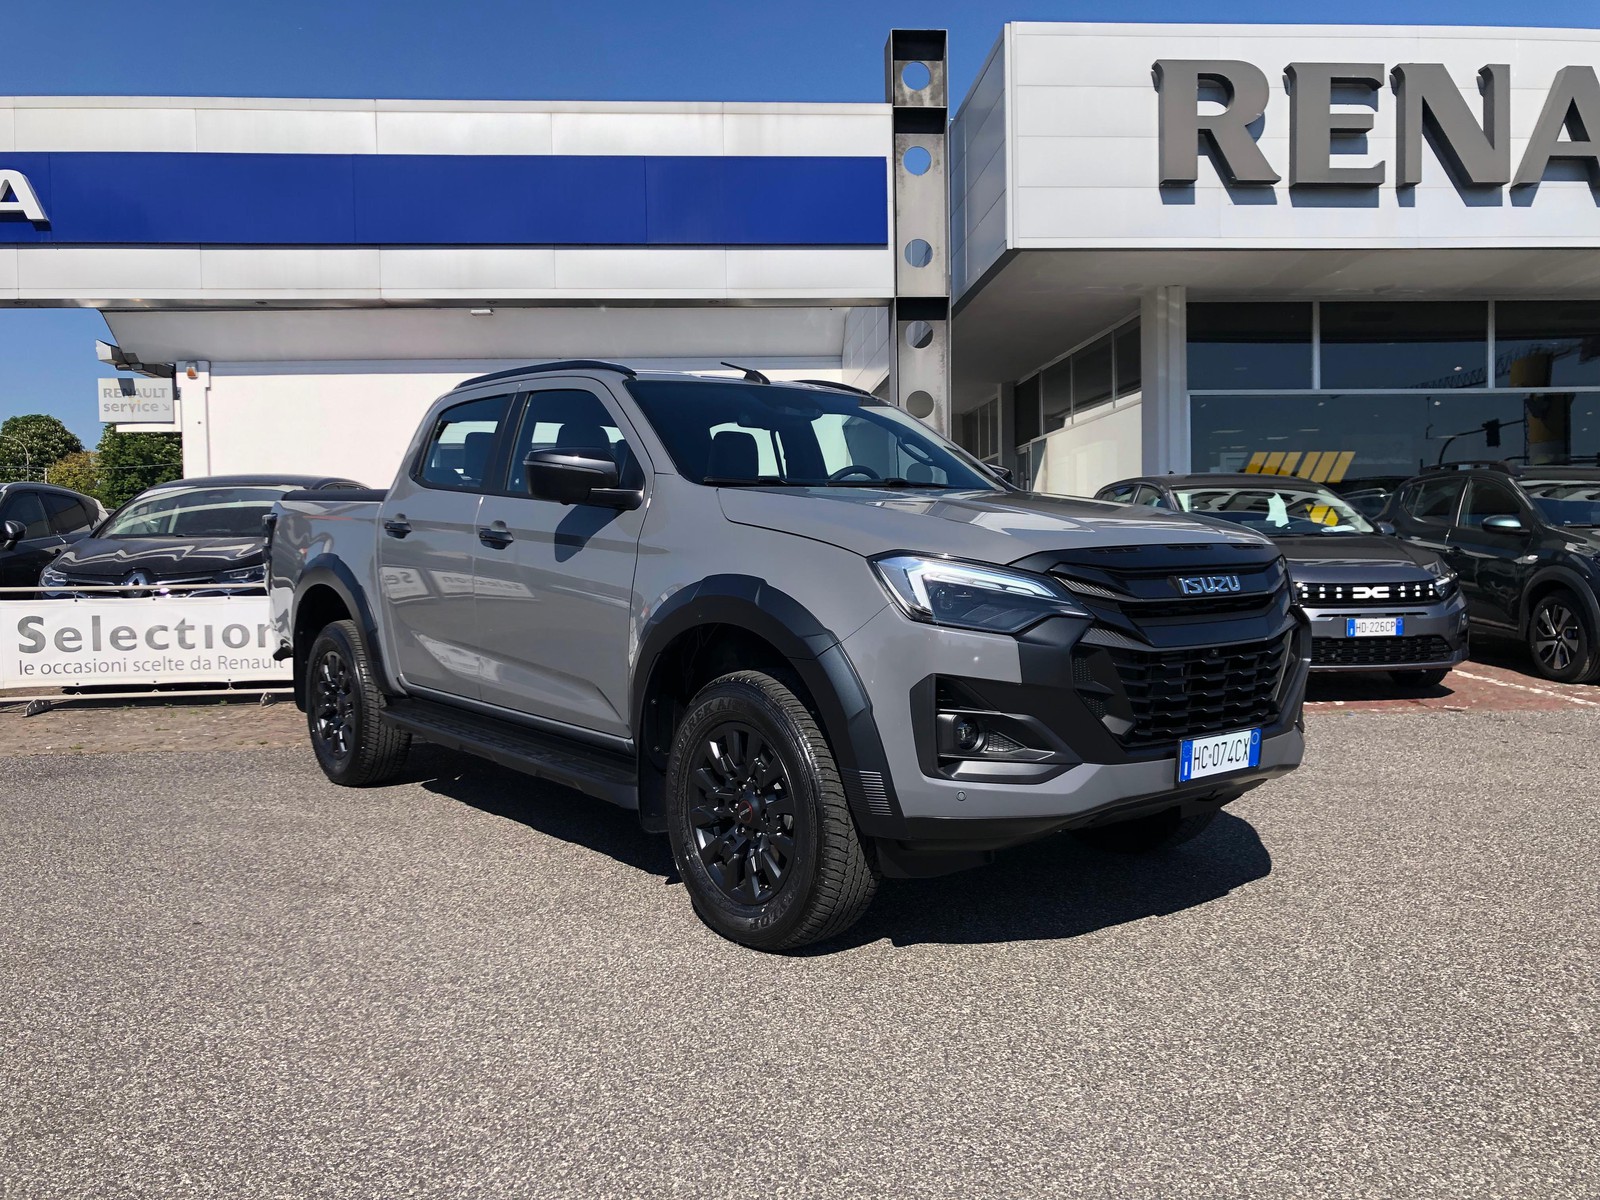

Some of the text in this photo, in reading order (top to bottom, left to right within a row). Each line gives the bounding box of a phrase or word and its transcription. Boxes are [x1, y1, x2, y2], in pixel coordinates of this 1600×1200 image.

[1151, 59, 1600, 188] RENA
[103, 388, 168, 398] RENAULT
[103, 400, 159, 412] service
[1178, 575, 1241, 594] ISUZU
[19, 655, 284, 675] le occasioni scelte da Renault
